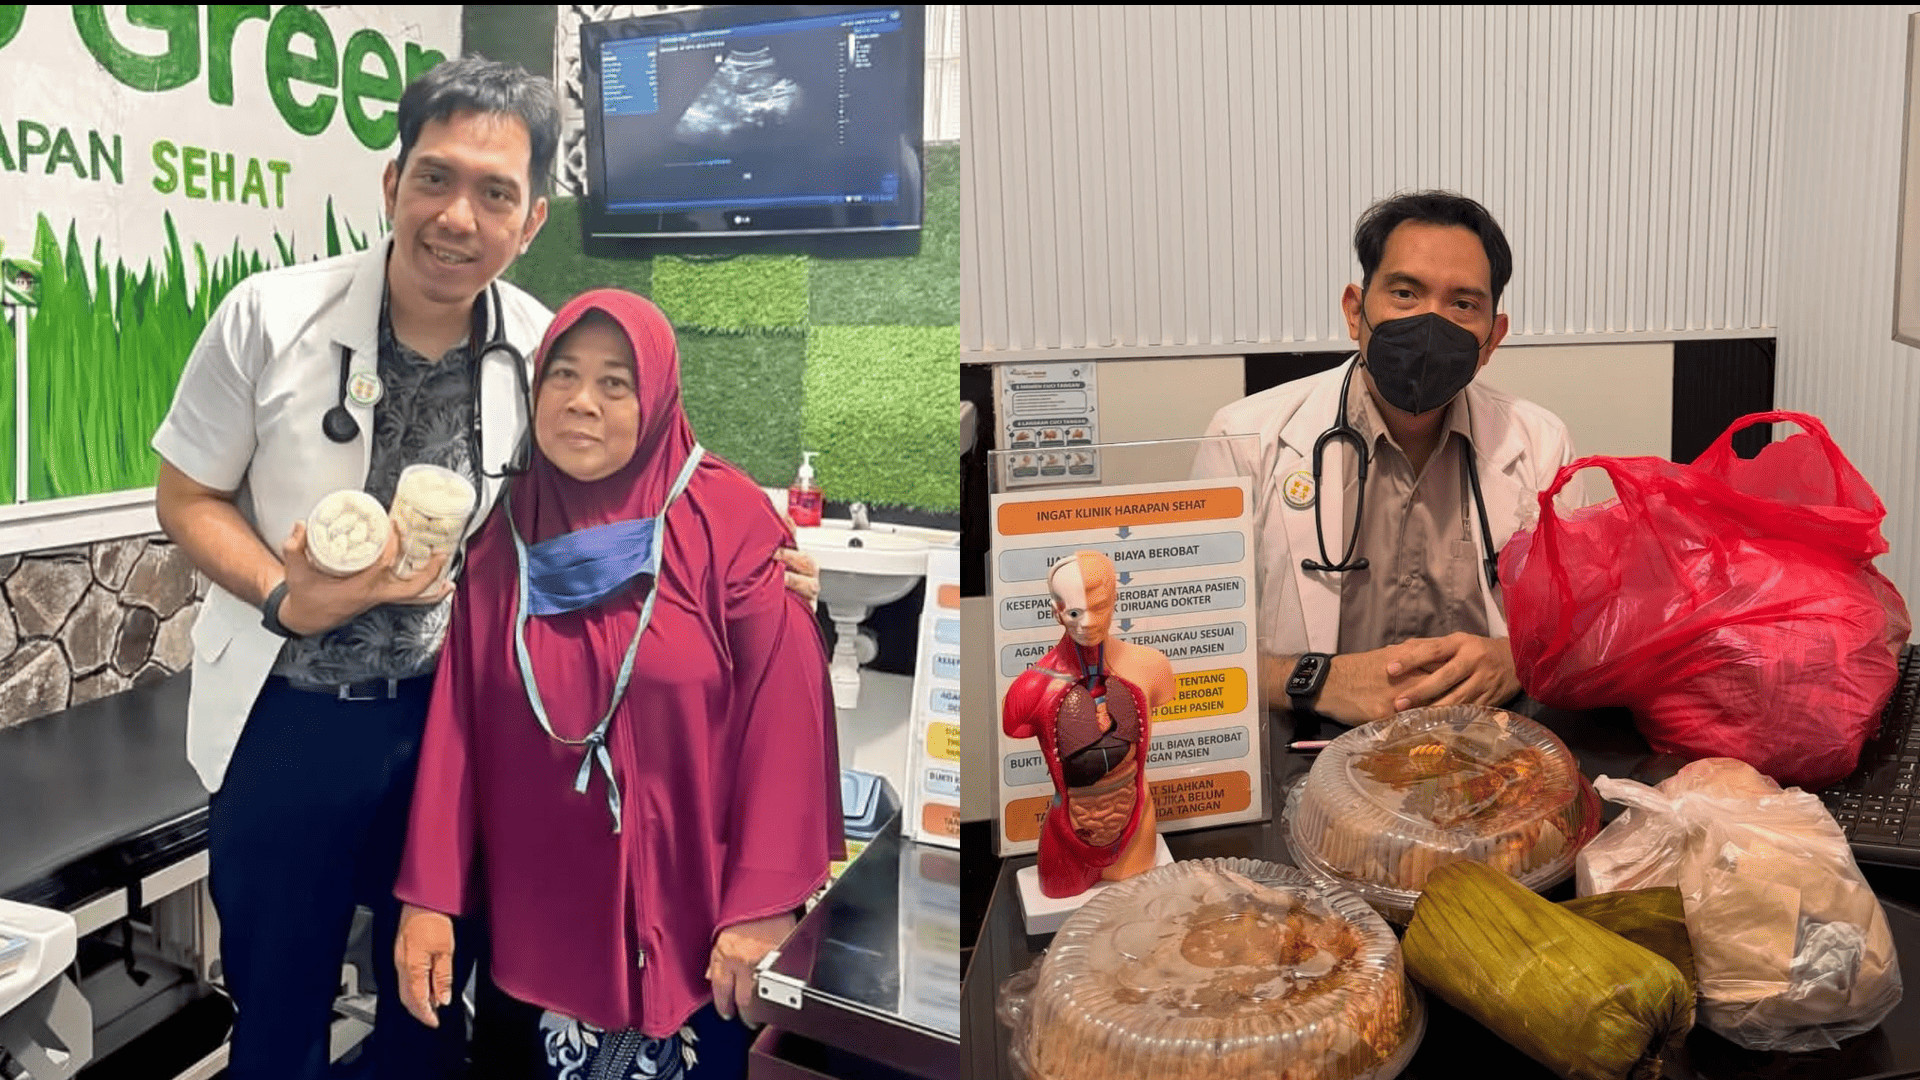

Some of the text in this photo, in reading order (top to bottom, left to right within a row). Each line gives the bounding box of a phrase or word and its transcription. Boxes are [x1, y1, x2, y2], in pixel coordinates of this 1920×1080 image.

[151, 139, 291, 209] SEHAT
[1037, 499, 1207, 522] INGAT KLINIK HARAPAN SEHAT
[1114, 549, 1146, 562] BIAYA
[1149, 545, 1200, 559] BEROBAT
[1006, 598, 1052, 611] KESEPAK
[1161, 585, 1202, 598] ANTARA
[1204, 581, 1240, 593] PASIEN
[1121, 599, 1169, 612] DIRUANG
[1171, 595, 1211, 607] DOKTER
[1015, 646, 1046, 658] AGAR
[1131, 630, 1198, 646] TERJANGKAU
[1201, 627, 1235, 639] SESUAI
[1190, 642, 1225, 655] PASIEN
[1179, 673, 1225, 686] TENTANG
[1179, 687, 1224, 700] BEROBAT
[1160, 704, 1187, 716] OLEH
[1189, 700, 1224, 712] PASIEN
[1010, 756, 1042, 769] BUKTI
[1167, 738, 1195, 750] BIAYA
[1197, 732, 1243, 746] BEROBAT
[1175, 747, 1210, 760] PASIEN
[1162, 779, 1214, 795] SILAHKAN
[1161, 793, 1186, 807] JIKA
[1188, 788, 1225, 802] BELUM
[1177, 800, 1221, 815] TANGAN
